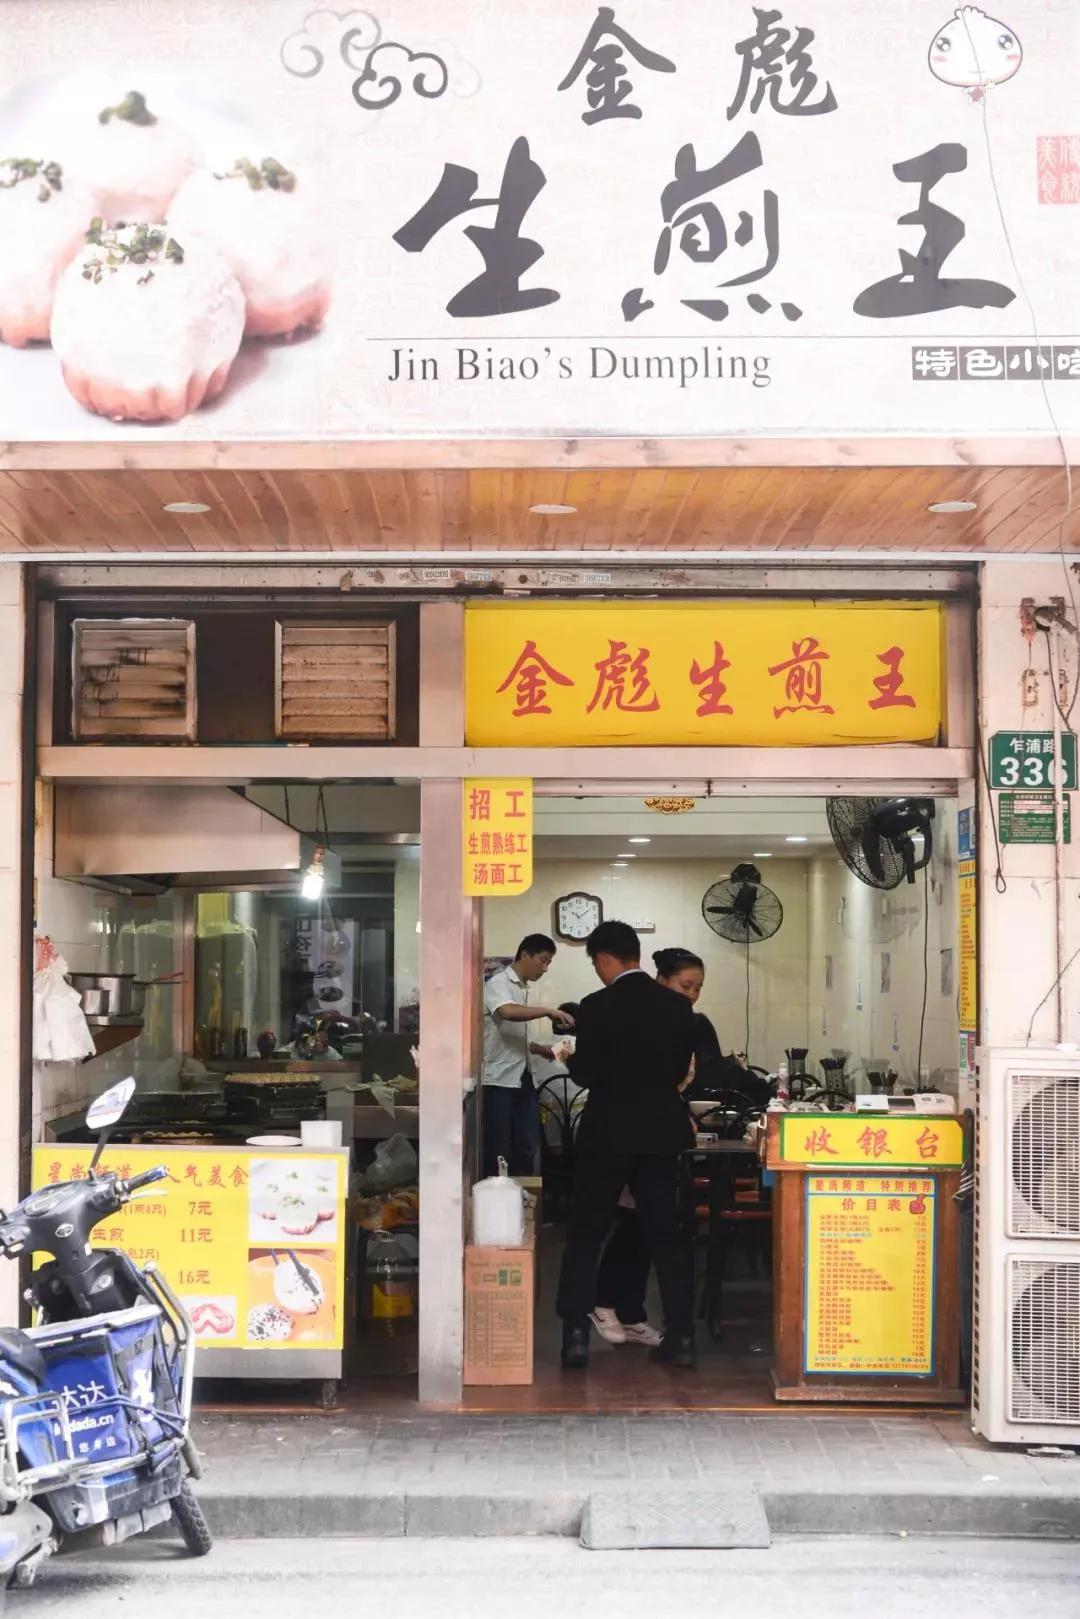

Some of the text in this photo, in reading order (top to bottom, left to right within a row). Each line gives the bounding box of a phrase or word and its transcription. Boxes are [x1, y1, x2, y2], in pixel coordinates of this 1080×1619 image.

[557, 7, 838, 126] 金彪
[392, 131, 1017, 322] 生煎王
[388, 349, 439, 381] Jin
[589, 348, 772, 388] Dumpling
[496, 638, 916, 718] 金彪生煎王
[1000, 757, 1068, 786] 336
[470, 788, 526, 820] 招工
[468, 832, 528, 855] 生煎熟练工
[473, 863, 523, 885] 汤面工
[804, 1126, 939, 1159] 收银台
[188, 1201, 212, 1216] 7元
[842, 1198, 901, 1211] 价目表
[92, 1227, 212, 1243] 生煎 11元
[178, 1269, 211, 1286] 16元
